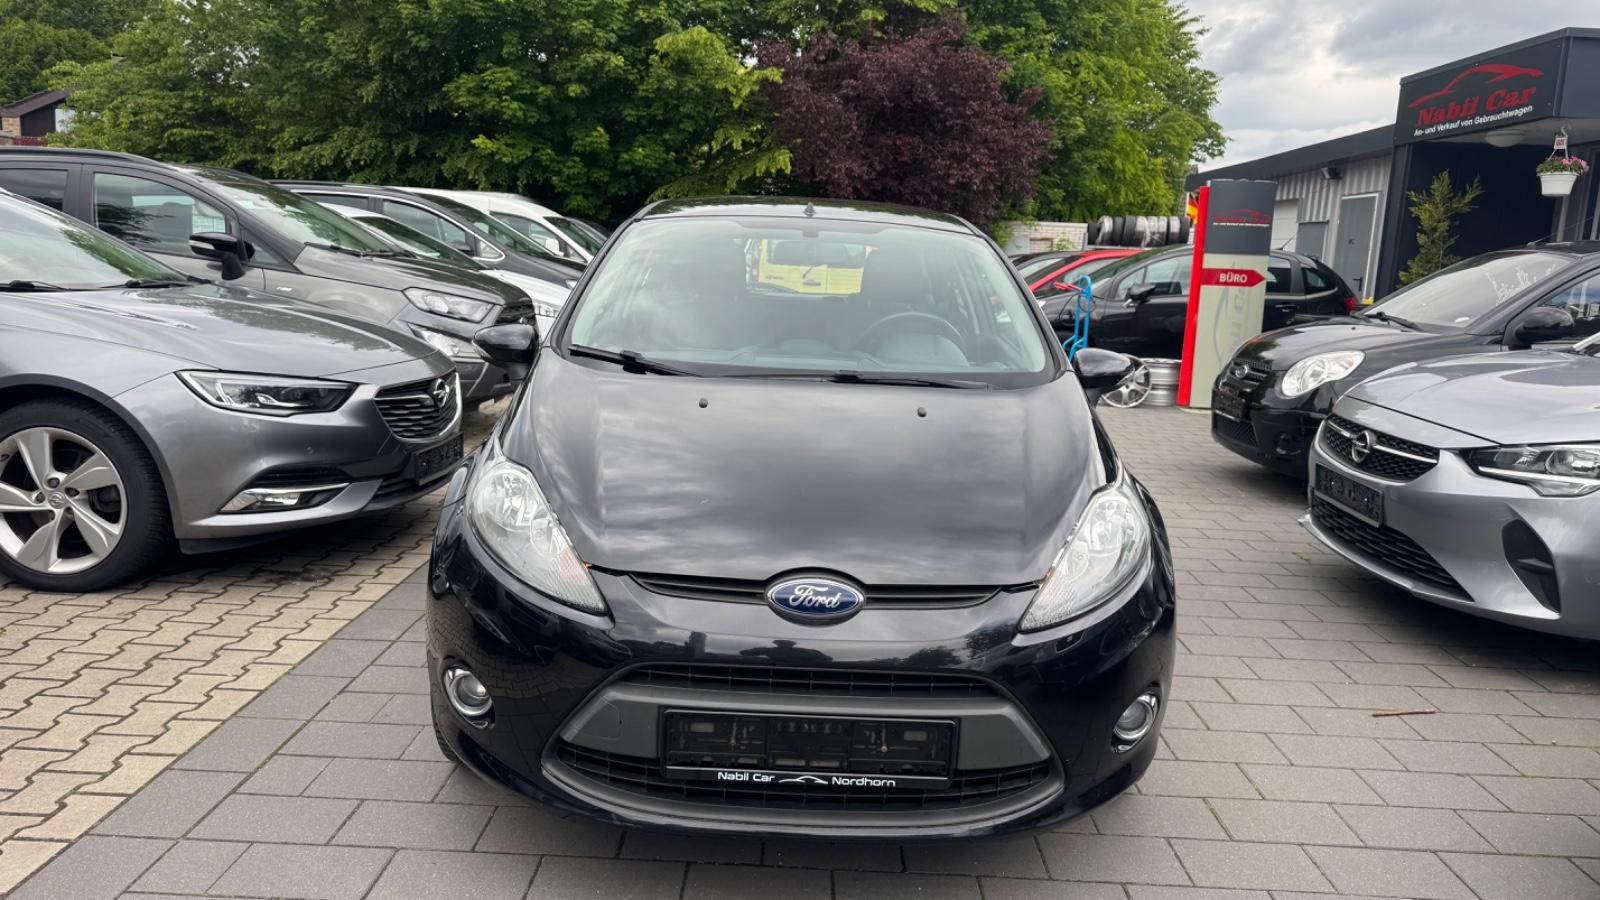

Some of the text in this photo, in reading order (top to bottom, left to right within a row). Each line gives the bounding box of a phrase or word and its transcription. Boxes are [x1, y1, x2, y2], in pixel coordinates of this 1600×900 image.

[1416, 87, 1537, 128] Nabil Car
[1425, 124, 1437, 134] und
[1437, 120, 1461, 131] Verkauf
[1461, 119, 1473, 127] von
[1474, 105, 1533, 124] Gebrauchtwagen
[1219, 272, 1248, 283] BÜRO
[789, 585, 842, 608] Ford
[718, 772, 896, 787] Nabil Car Nordhorn
